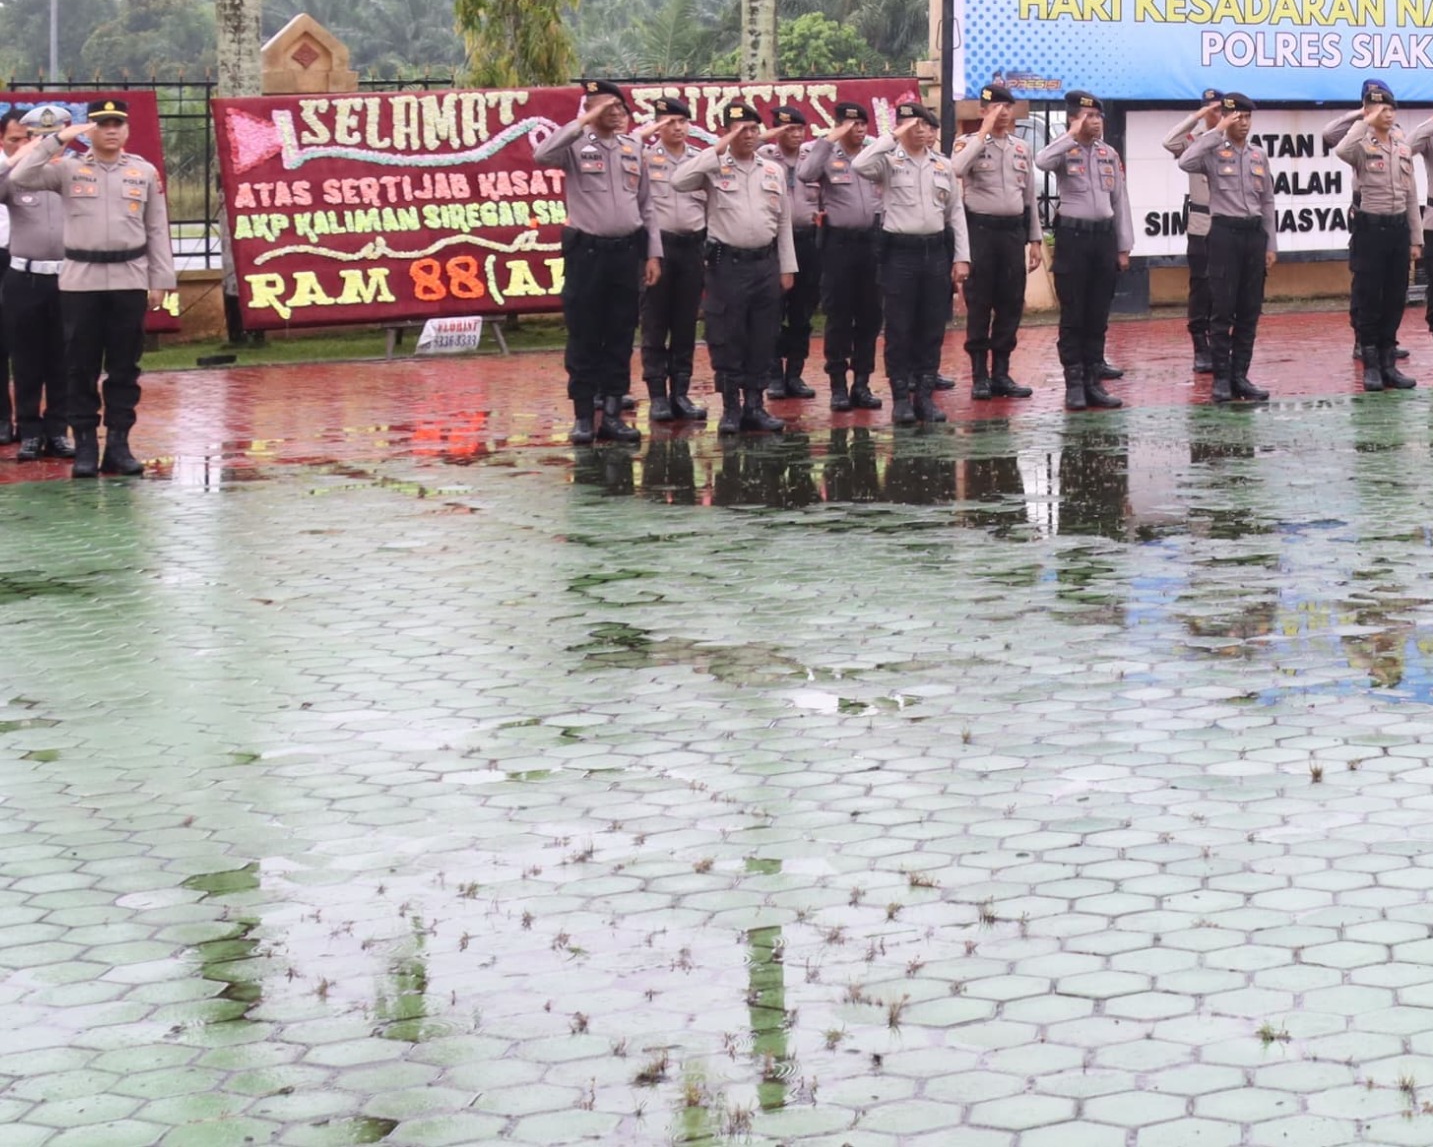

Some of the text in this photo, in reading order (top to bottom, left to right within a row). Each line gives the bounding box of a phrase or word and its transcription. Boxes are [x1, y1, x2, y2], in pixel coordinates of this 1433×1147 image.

[1201, 30, 1343, 68] POLRES
[1006, 79, 1062, 90] PRESISI
[299, 91, 529, 151] SELAMAT
[234, 169, 566, 208] ATAS SERTIJAB KASAT
[1271, 171, 1342, 195] ALAH
[234, 213, 290, 242] AKP
[293, 206, 421, 244] KALIMAN
[1275, 208, 1353, 234] ASYA
[244, 267, 396, 320] RAM
